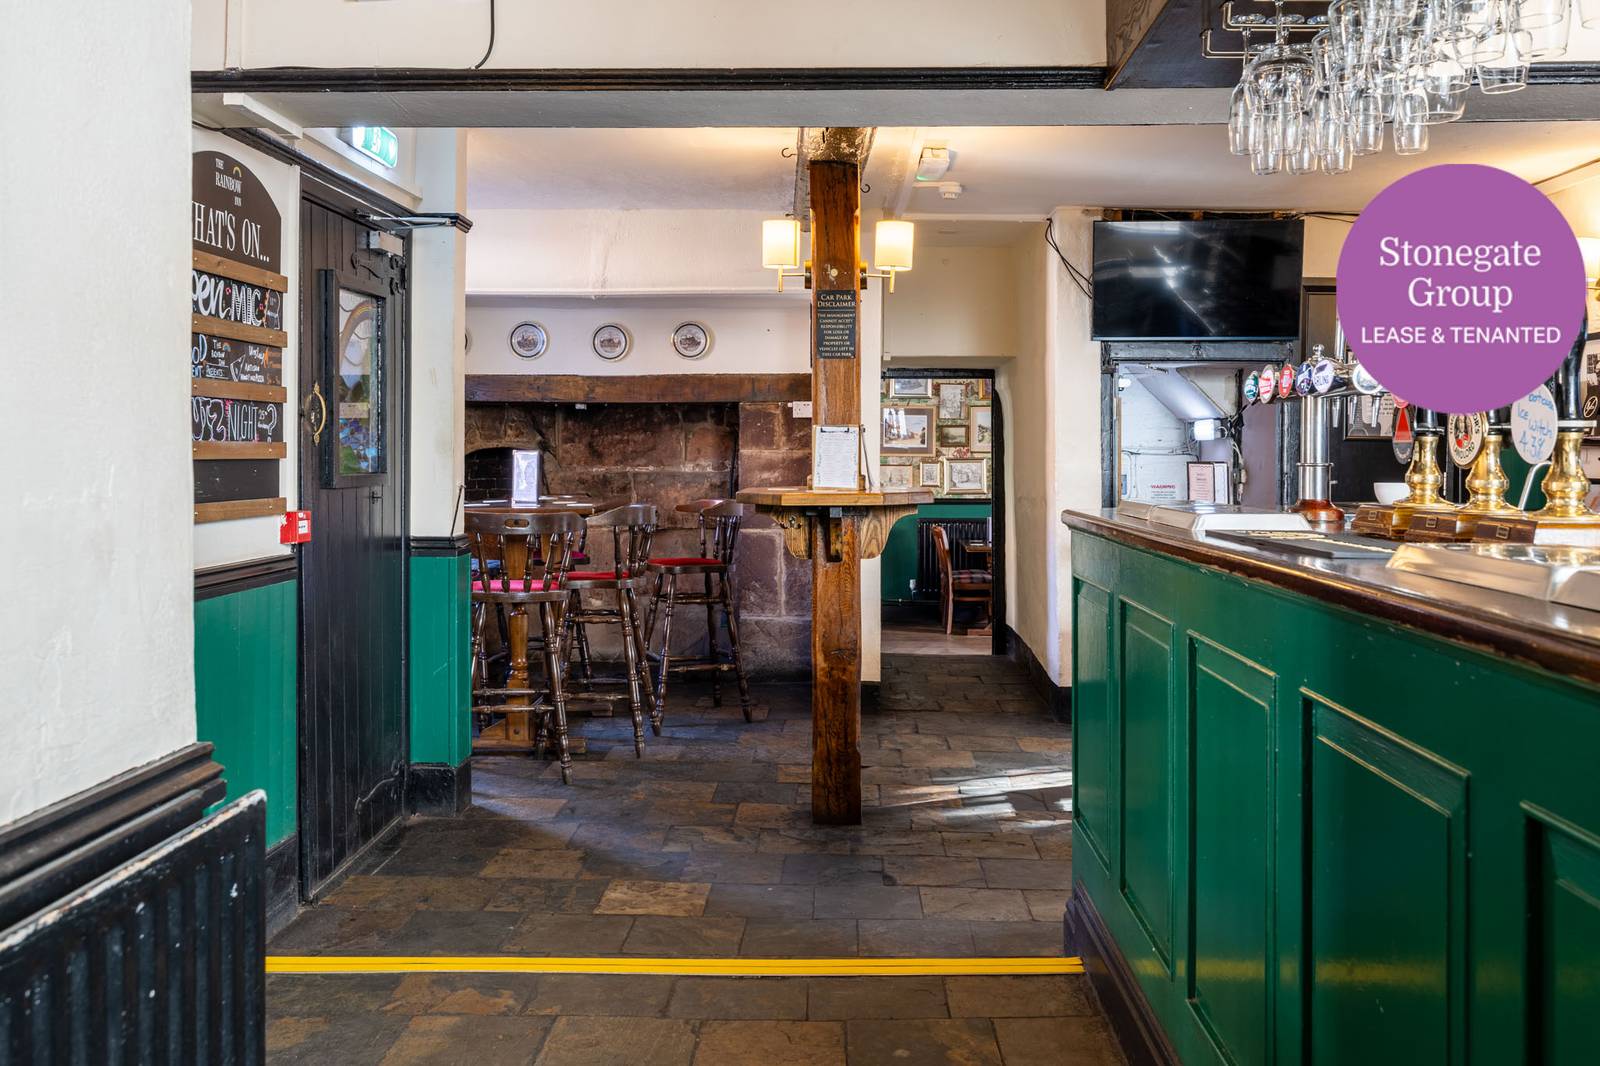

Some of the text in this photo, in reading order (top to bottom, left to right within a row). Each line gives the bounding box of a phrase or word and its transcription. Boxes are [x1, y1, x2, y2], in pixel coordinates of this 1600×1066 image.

[215, 158, 224, 170] THE
[215, 172, 242, 194] RAINBOW
[234, 196, 242, 207] INN
[192, 201, 236, 252] HAT'S
[231, 283, 262, 327] MIC
[228, 402, 258, 441] NIGHT
